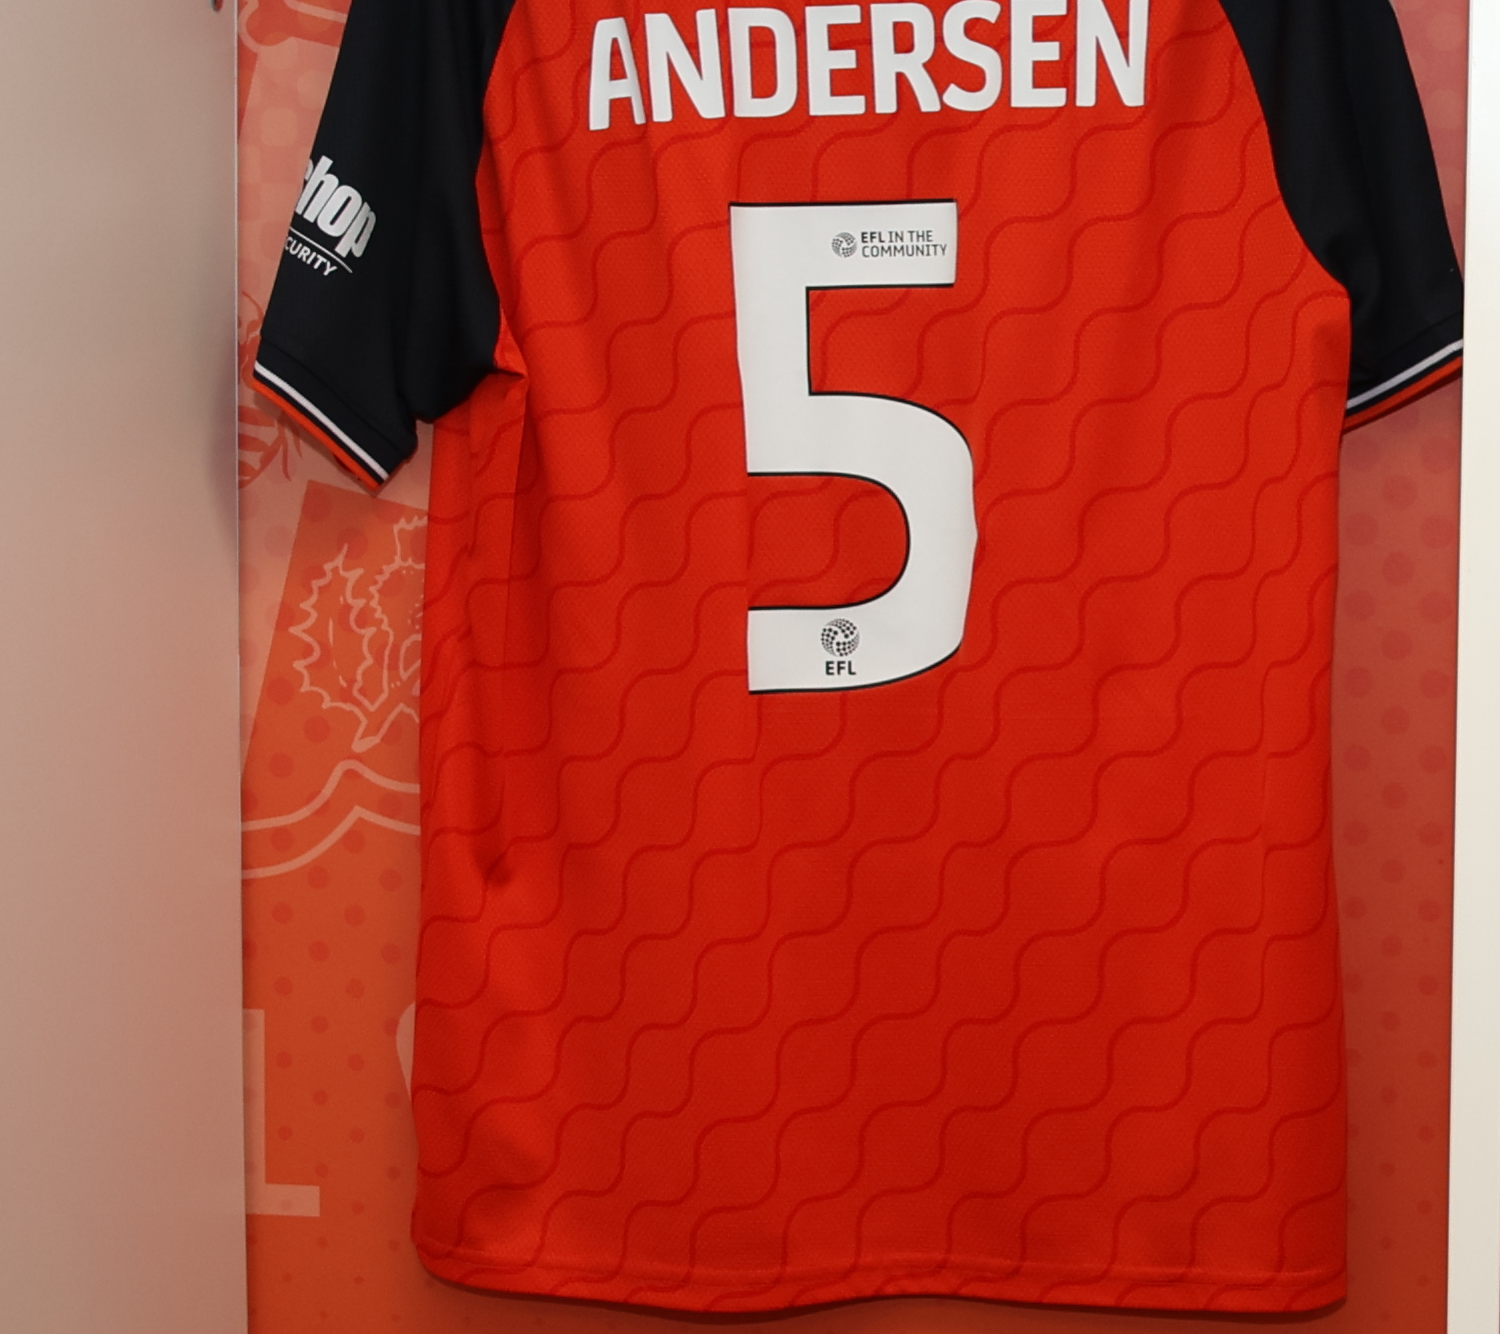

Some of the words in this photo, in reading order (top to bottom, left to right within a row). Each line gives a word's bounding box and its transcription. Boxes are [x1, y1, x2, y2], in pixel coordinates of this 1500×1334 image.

[295, 154, 377, 258] hop
[861, 231, 885, 244] EFL
[888, 231, 904, 243] IN
[908, 230, 933, 243] THE
[862, 243, 948, 258] COMMUNITY
[729, 198, 979, 695] 5
[825, 661, 857, 676] EFL
